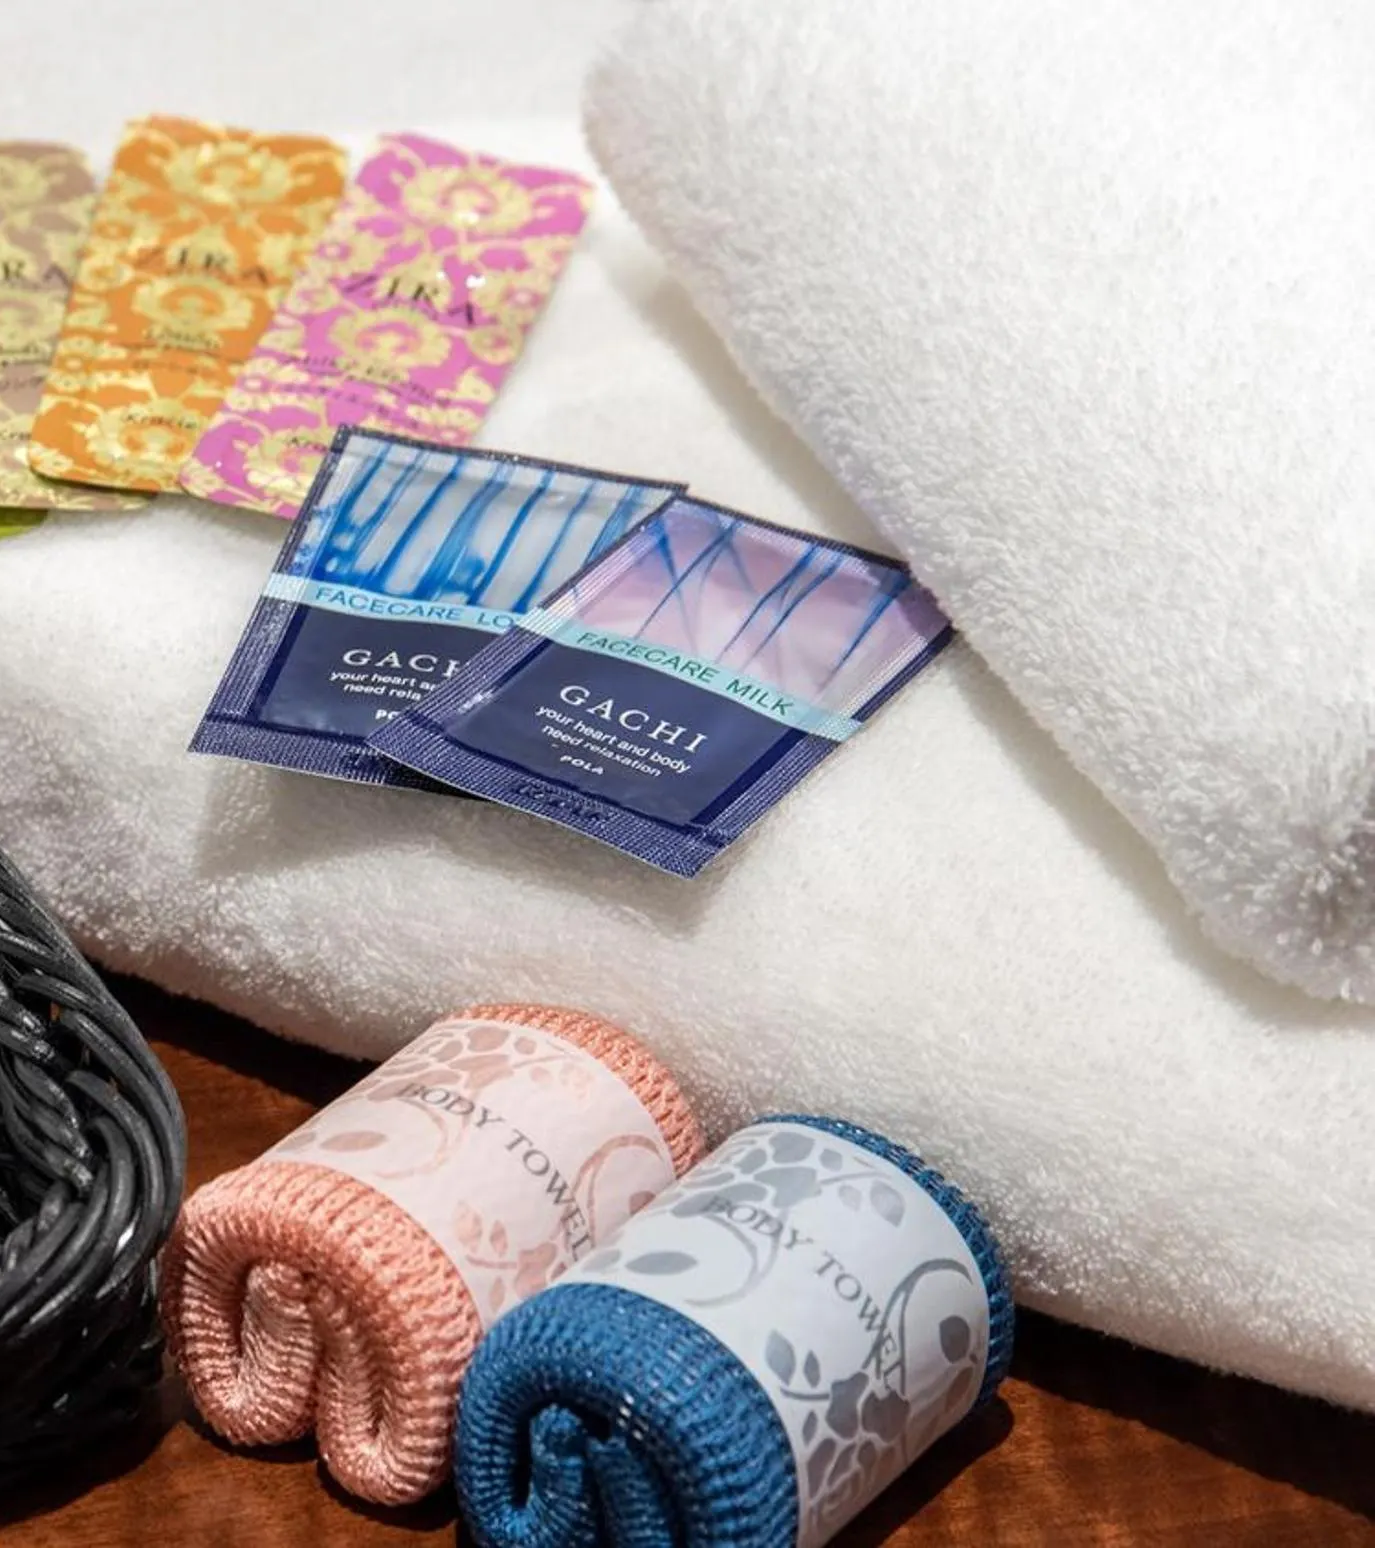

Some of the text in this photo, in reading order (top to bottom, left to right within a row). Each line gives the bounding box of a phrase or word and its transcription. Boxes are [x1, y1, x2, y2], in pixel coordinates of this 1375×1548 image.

[315, 587, 462, 622] FACECARE
[329, 669, 367, 681] your
[371, 672, 417, 688] heart
[343, 683, 386, 697] need
[575, 631, 796, 717] FACECARE MILK
[535, 705, 692, 775] your heart and body
[559, 685, 708, 753] GACHI
[541, 723, 662, 778] need relaxation
[559, 754, 605, 776] POLA
[397, 1082, 593, 1263] BODY TOWEL
[700, 1195, 902, 1393] BODY TOWEL
